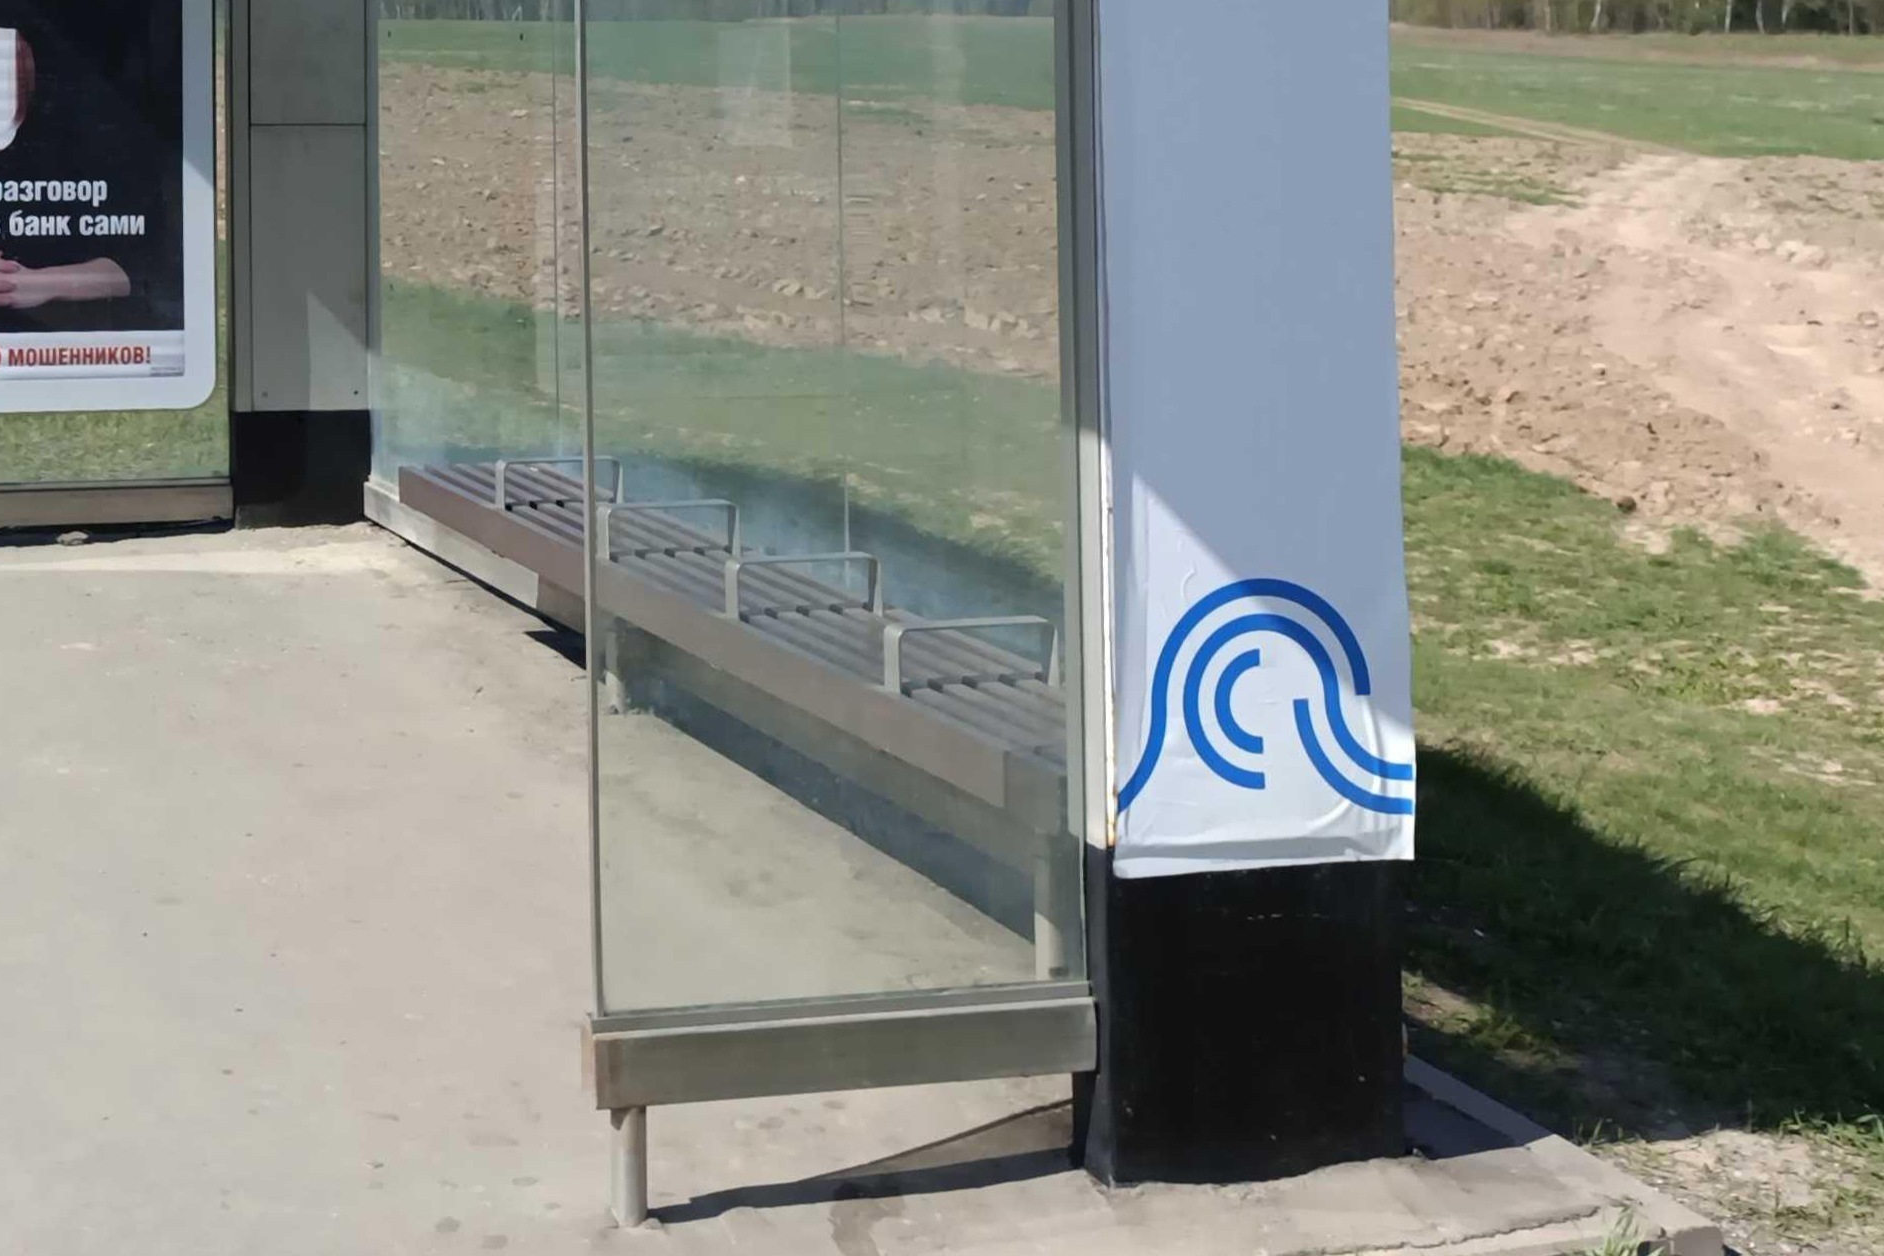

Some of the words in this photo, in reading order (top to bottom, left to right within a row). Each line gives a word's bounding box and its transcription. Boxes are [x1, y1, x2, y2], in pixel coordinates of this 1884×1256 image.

[9, 210, 71, 236] банк
[79, 214, 145, 236] сами
[8, 346, 152, 368] МОШЕННИКОВ!
